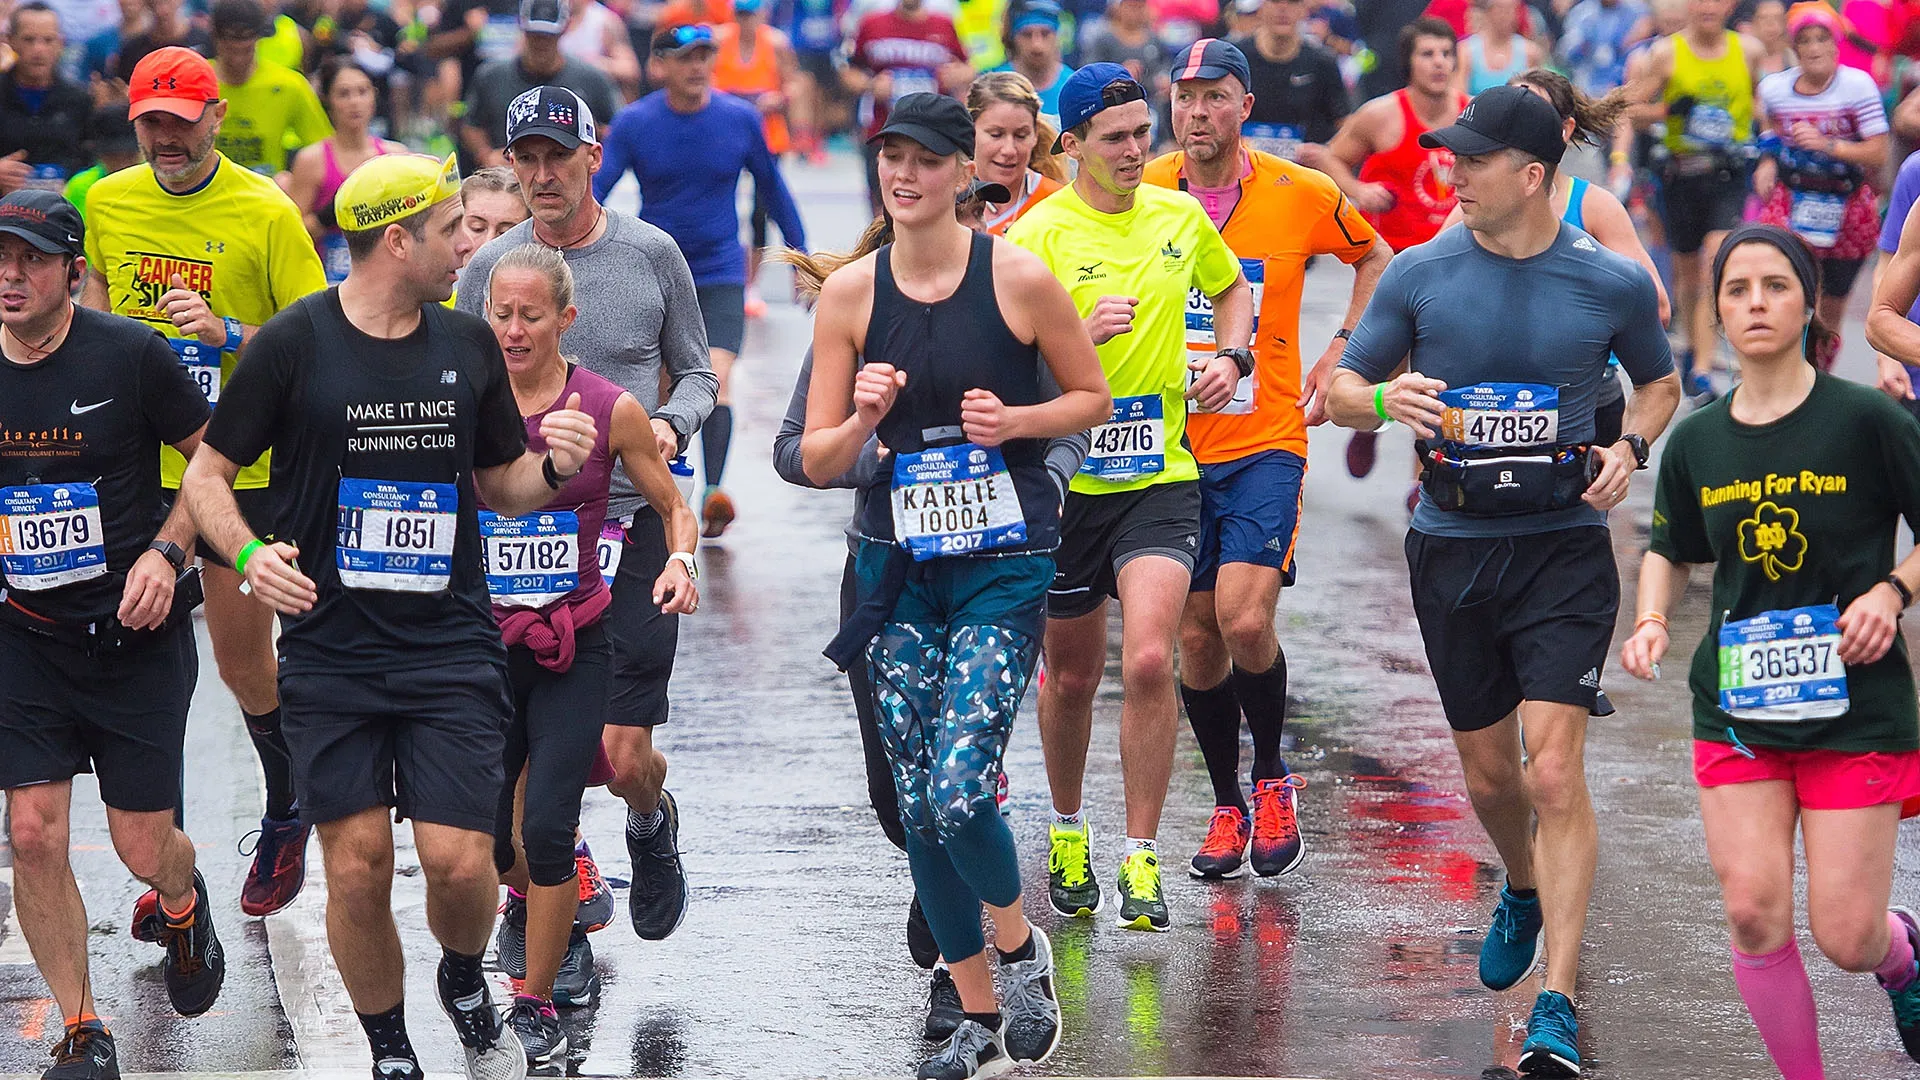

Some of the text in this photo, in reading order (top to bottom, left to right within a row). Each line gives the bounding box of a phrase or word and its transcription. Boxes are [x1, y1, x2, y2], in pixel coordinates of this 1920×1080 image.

[139, 257, 213, 291] CANCER
[346, 400, 456, 421] MAKE IT NICE
[1470, 416, 1549, 443] 47852
[348, 433, 456, 452] RUNNING CLUB
[1094, 424, 1153, 454] 43716
[921, 452, 946, 463] TATA
[1104, 457, 1132, 468] 2017
[907, 460, 959, 473] CONSULTANCY
[968, 463, 990, 474] TATA
[916, 470, 953, 481] SERVICES
[377, 485, 397, 493] TATA
[903, 479, 998, 510] KARLIE
[1701, 470, 1847, 507] Running For Ryan
[4, 497, 43, 505] CONSULTANCY
[363, 491, 411, 501] CONSULTANCY
[11, 504, 36, 512] SERVICES
[52, 500, 73, 508] TATA
[371, 499, 402, 508] SERVICES
[418, 501, 438, 509] TATA
[485, 520, 529, 528] CONSULTANCY
[920, 505, 989, 533] 10004
[18, 514, 90, 550] 13679
[347, 530, 358, 548] A
[385, 517, 436, 549] 1851
[941, 533, 983, 552] 2017
[33, 552, 66, 568] 2017
[385, 556, 419, 568] 2017
[498, 540, 569, 571] 57182
[513, 577, 545, 589] 2017
[1740, 623, 1785, 634] CONSULTANCY
[1747, 631, 1777, 641] SERVICES
[1729, 648, 1740, 666] 2
[1750, 642, 1832, 680] 36537
[1763, 684, 1801, 701] 2017
